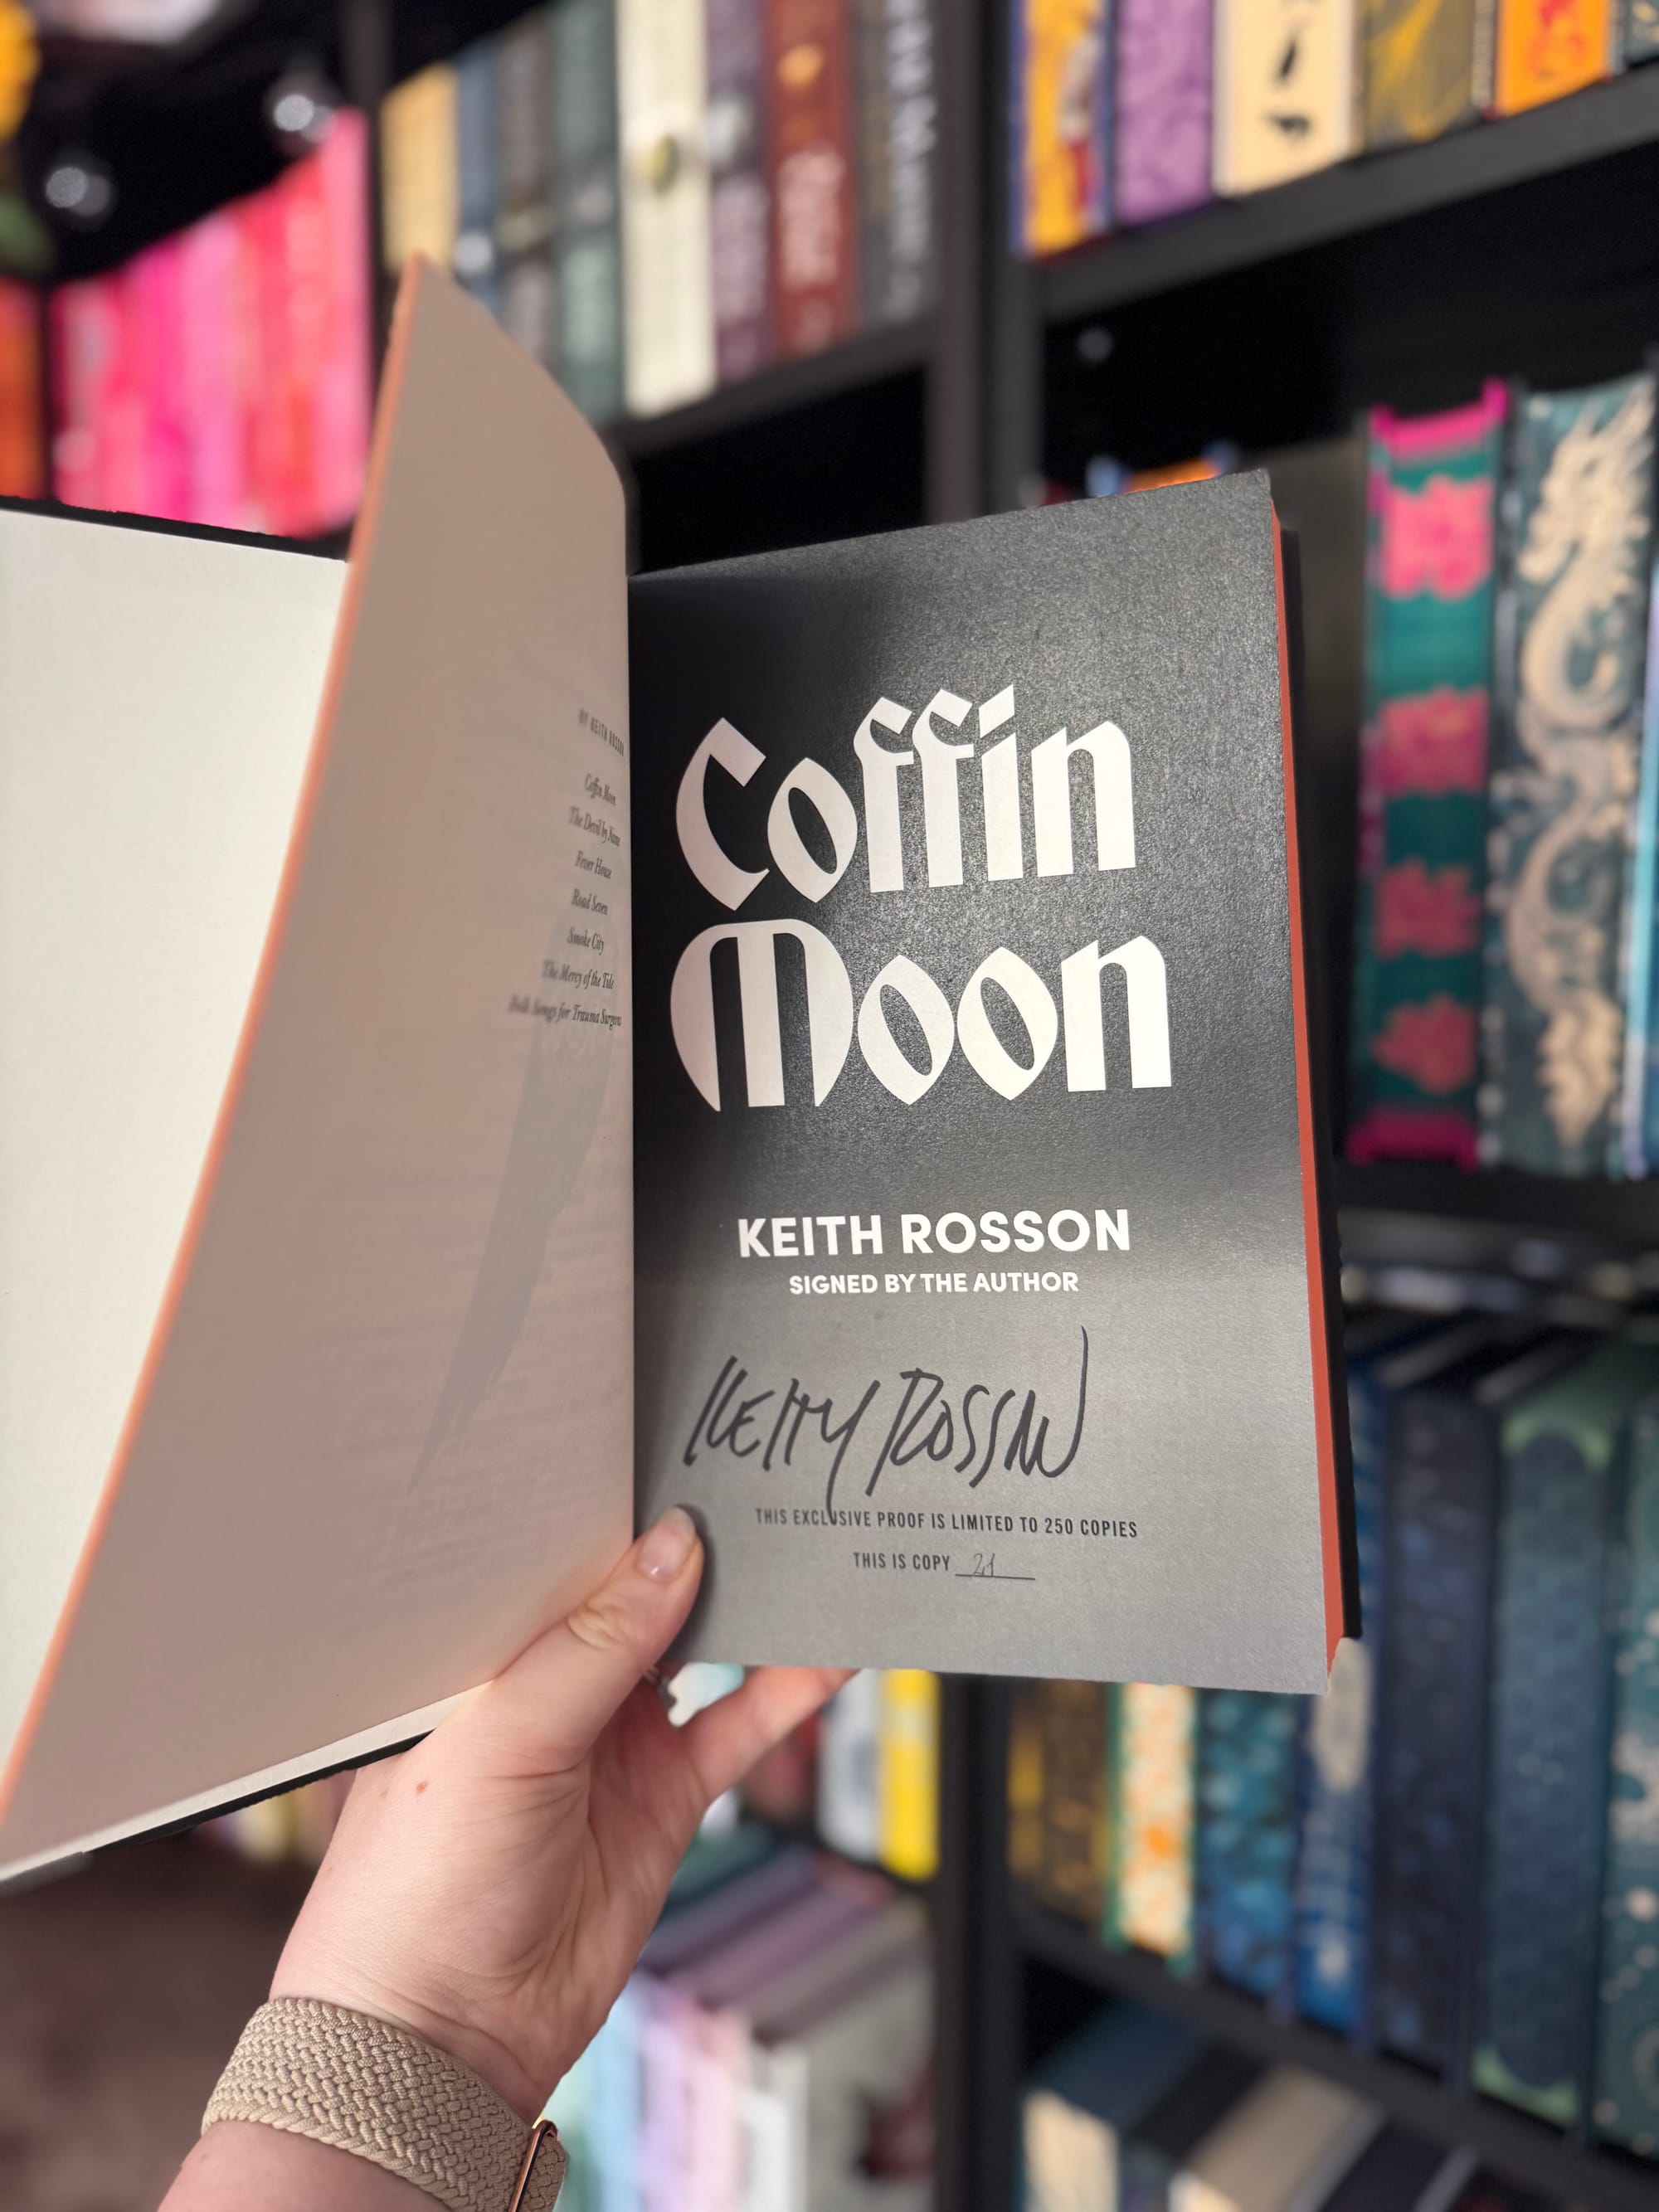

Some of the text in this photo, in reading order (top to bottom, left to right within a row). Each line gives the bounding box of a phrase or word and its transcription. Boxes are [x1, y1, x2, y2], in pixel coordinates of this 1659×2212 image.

[676, 684, 1136, 911] Coffin
[582, 969, 593, 990] of
[591, 970, 601, 987] the
[555, 1002, 571, 1023] for
[572, 1004, 600, 1023] Trauma
[670, 919, 1171, 1111] Moon
[737, 1208, 1131, 1257] KEITH ROSSON
[789, 1271, 1078, 1295] SIGNED BY THE AUTHOR
[755, 1508, 1137, 1538] THIS EXCLUSIVE PROOF IS LIMITED TO 250 COPIES
[853, 1552, 950, 1571] THIS IS COPY
